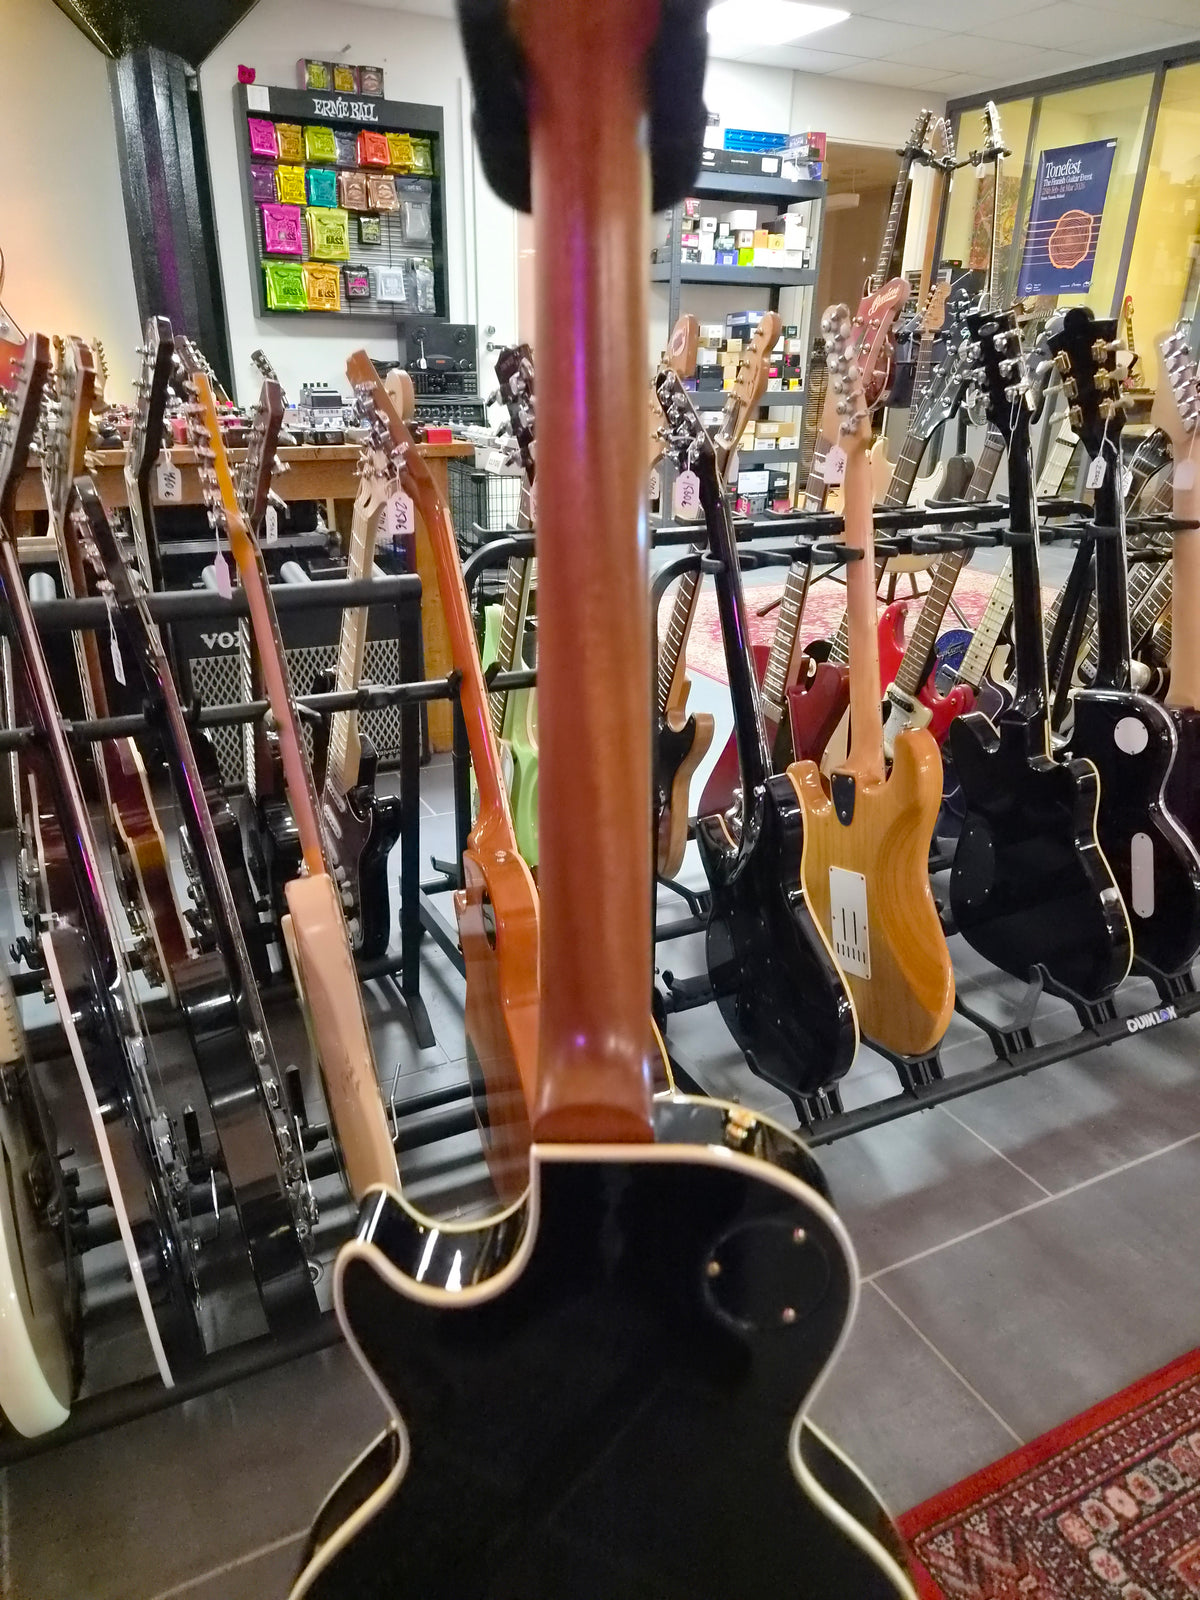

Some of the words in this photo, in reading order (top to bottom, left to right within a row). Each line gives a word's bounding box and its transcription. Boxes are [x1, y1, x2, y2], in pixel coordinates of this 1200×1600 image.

[312, 97, 349, 119] ERNIE
[350, 102, 379, 122] BALL
[1046, 159, 1082, 178] Tonefest
